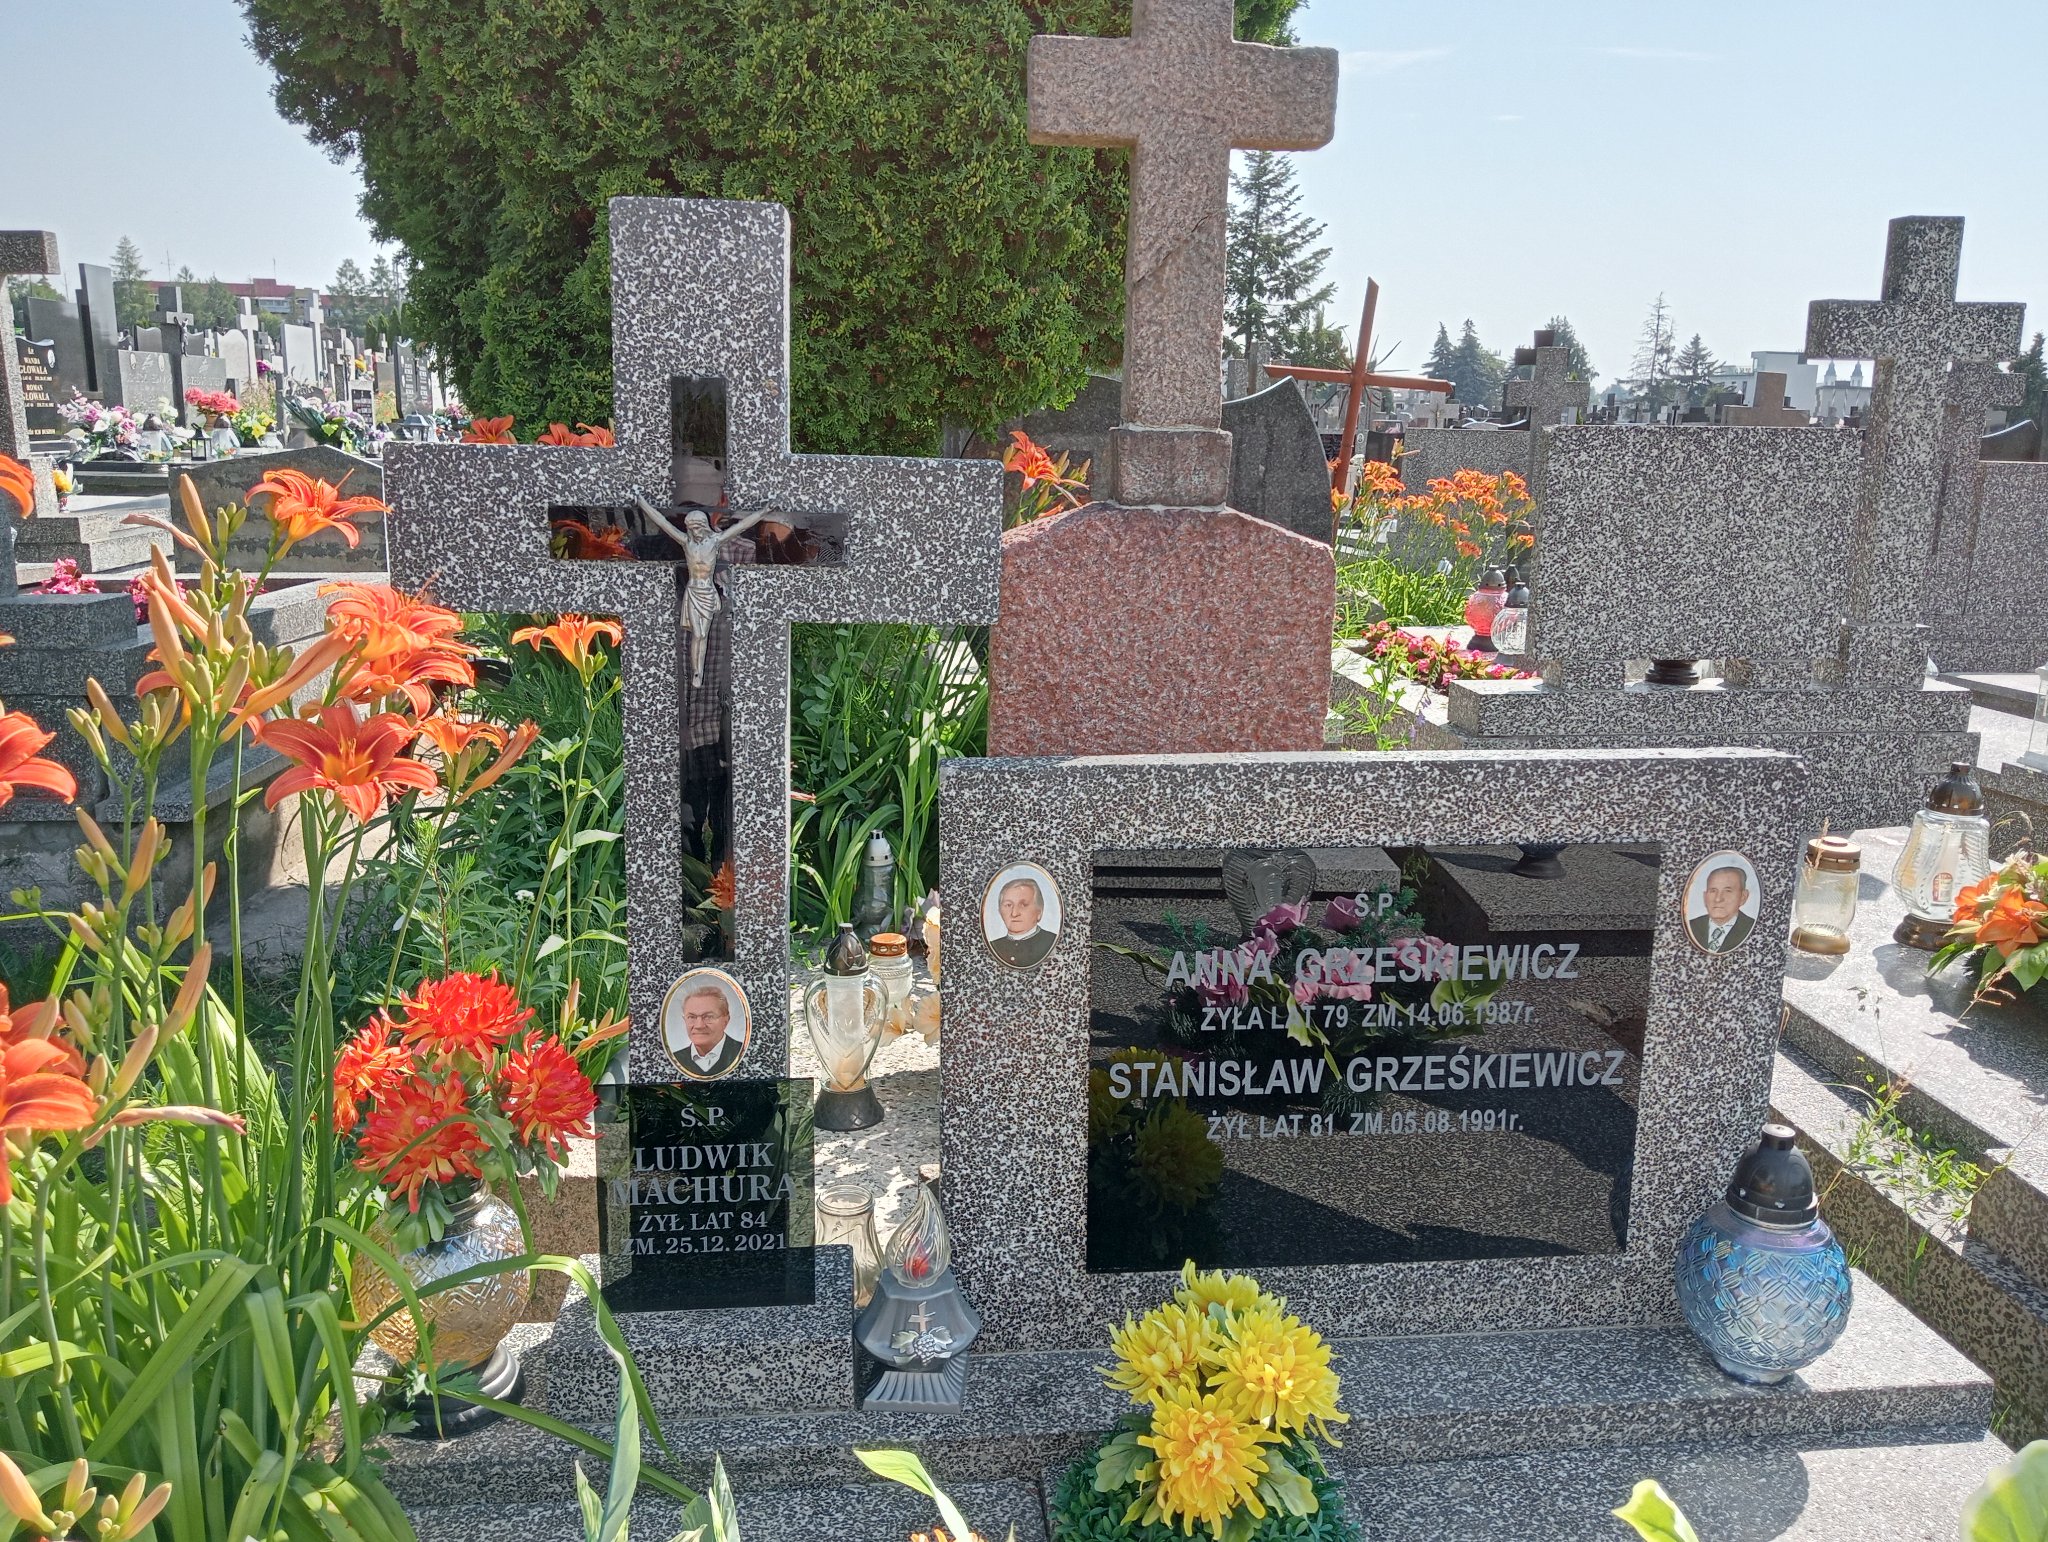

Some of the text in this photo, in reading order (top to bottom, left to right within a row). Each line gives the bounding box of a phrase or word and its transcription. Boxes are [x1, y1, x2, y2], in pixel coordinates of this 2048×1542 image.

[1165, 950, 1275, 987] ANNA
[1271, 1004, 1316, 1030] LAT
[1322, 1004, 1349, 1029] 79
[1108, 1047, 1627, 1099] STANISŁAW GRZEŚKIEWICZ
[1206, 1110, 1253, 1140] ŻYŁ
[1260, 1114, 1304, 1138] LAT
[1310, 1113, 1334, 1136] 81
[634, 1142, 775, 1172] LUDWIK
[611, 1172, 797, 1206] MACHURA
[639, 1210, 768, 1233] ŻYŁ LAT 84
